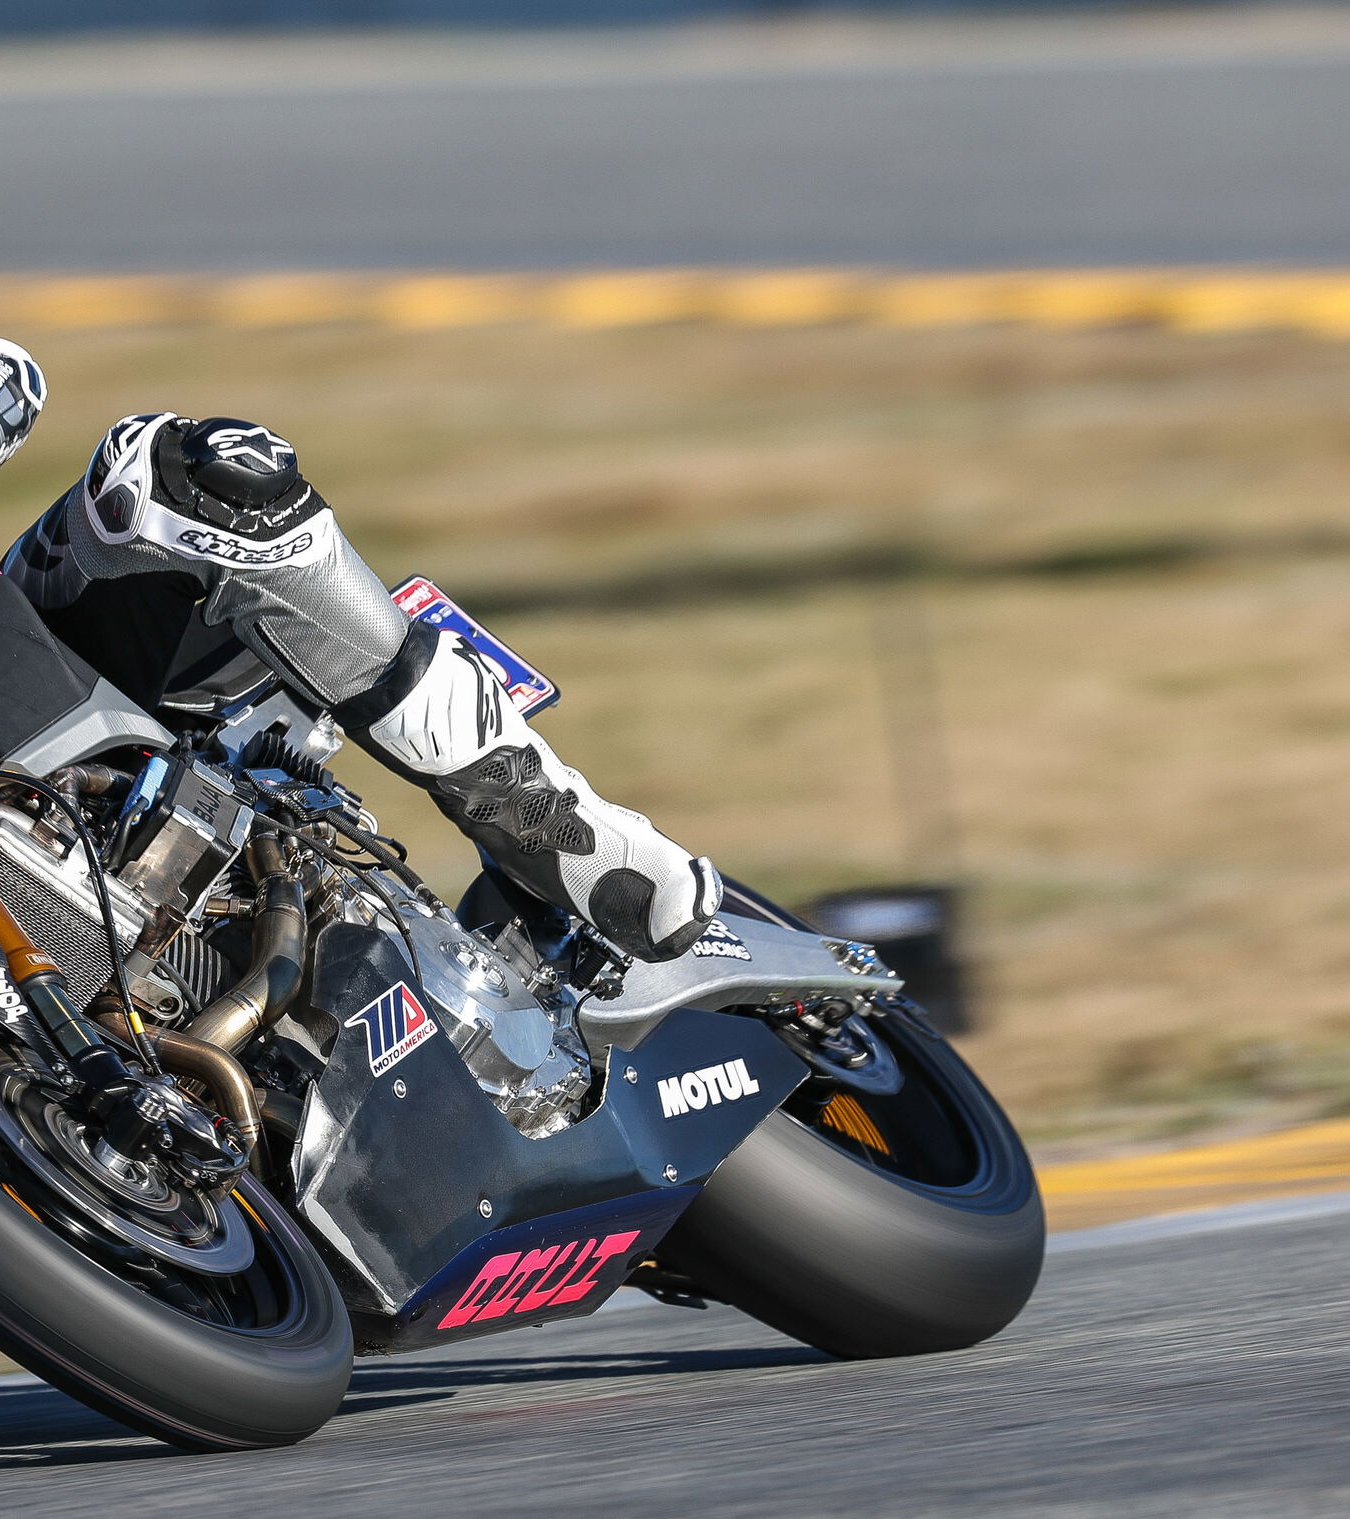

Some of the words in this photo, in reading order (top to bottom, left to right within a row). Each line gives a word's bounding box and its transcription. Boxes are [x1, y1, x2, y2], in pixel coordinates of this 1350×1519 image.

[180, 530, 312, 564] alpinestars
[194, 786, 221, 825] BAJA
[373, 1022, 436, 1075] MOTOAMERICA
[657, 1058, 760, 1119] MOTUL
